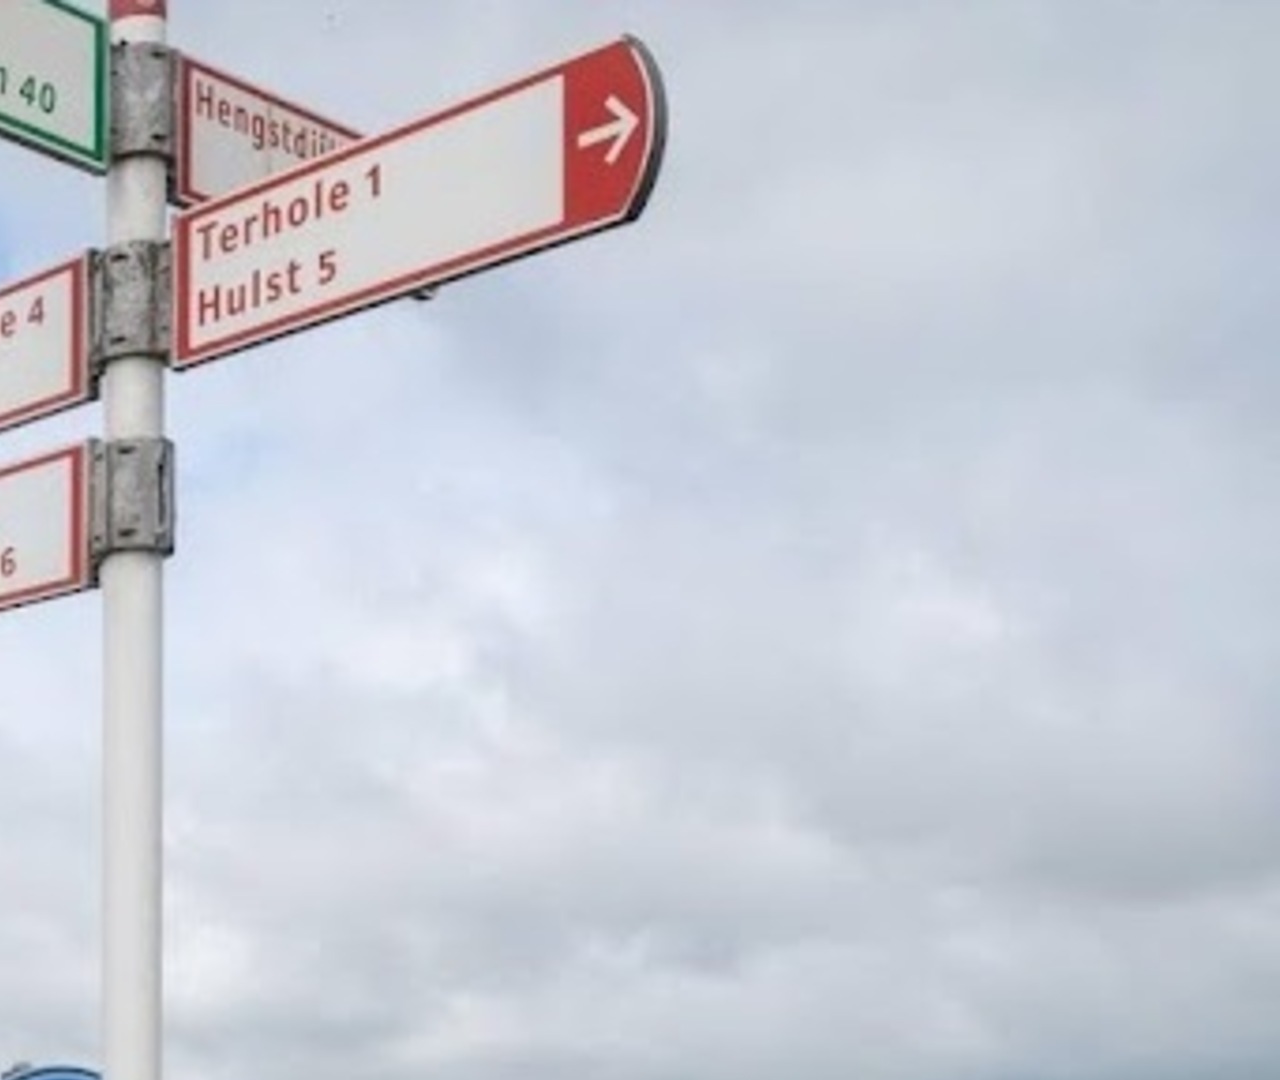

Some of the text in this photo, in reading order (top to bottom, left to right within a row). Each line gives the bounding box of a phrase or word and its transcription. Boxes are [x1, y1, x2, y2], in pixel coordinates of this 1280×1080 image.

[19, 76, 56, 114] 40
[197, 164, 381, 260] Terhole 1
[26, 296, 46, 326] 4
[198, 250, 337, 326] Hulst 5
